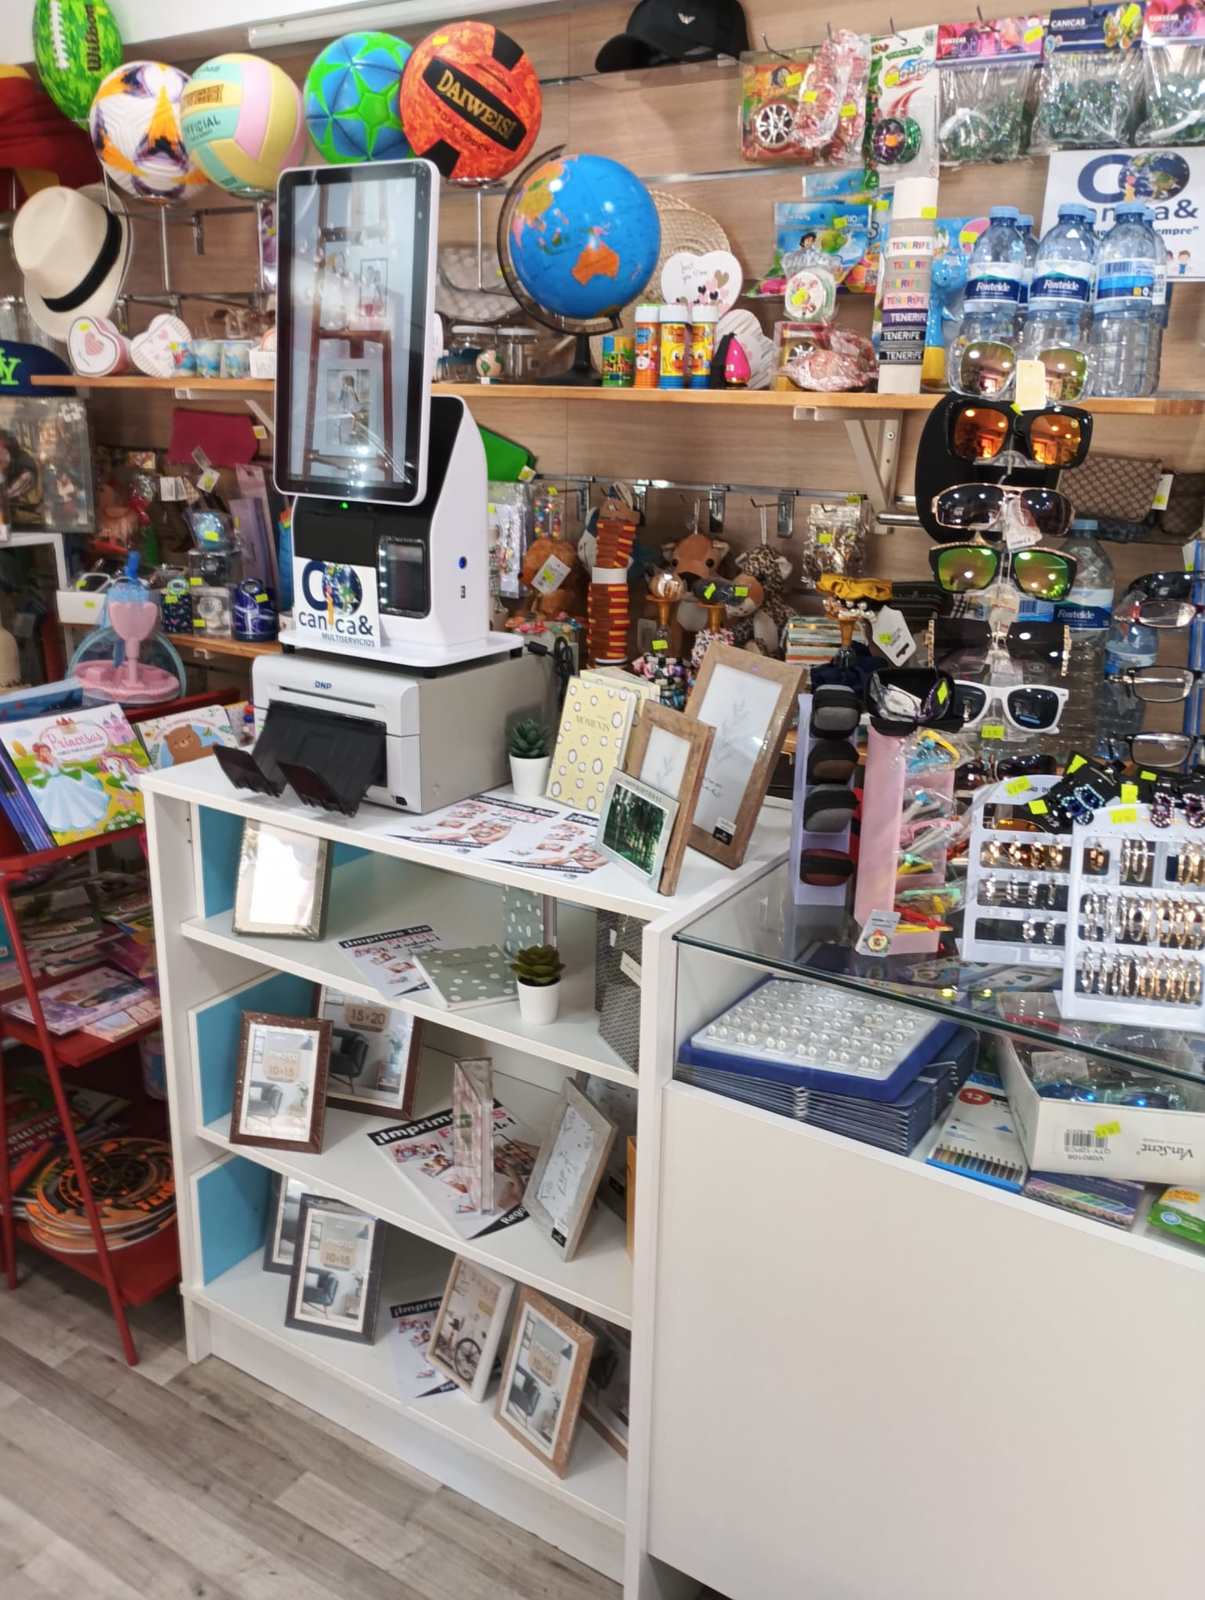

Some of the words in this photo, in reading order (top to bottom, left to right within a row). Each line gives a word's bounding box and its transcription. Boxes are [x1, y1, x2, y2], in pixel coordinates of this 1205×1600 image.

[1051, 18, 1086, 28] CANICAS
[86, 5, 101, 71] Wilson
[883, 331, 921, 341] TENERIFE
[321, 632, 376, 648] MULTISERVICIOS
[314, 680, 332, 690] DNP
